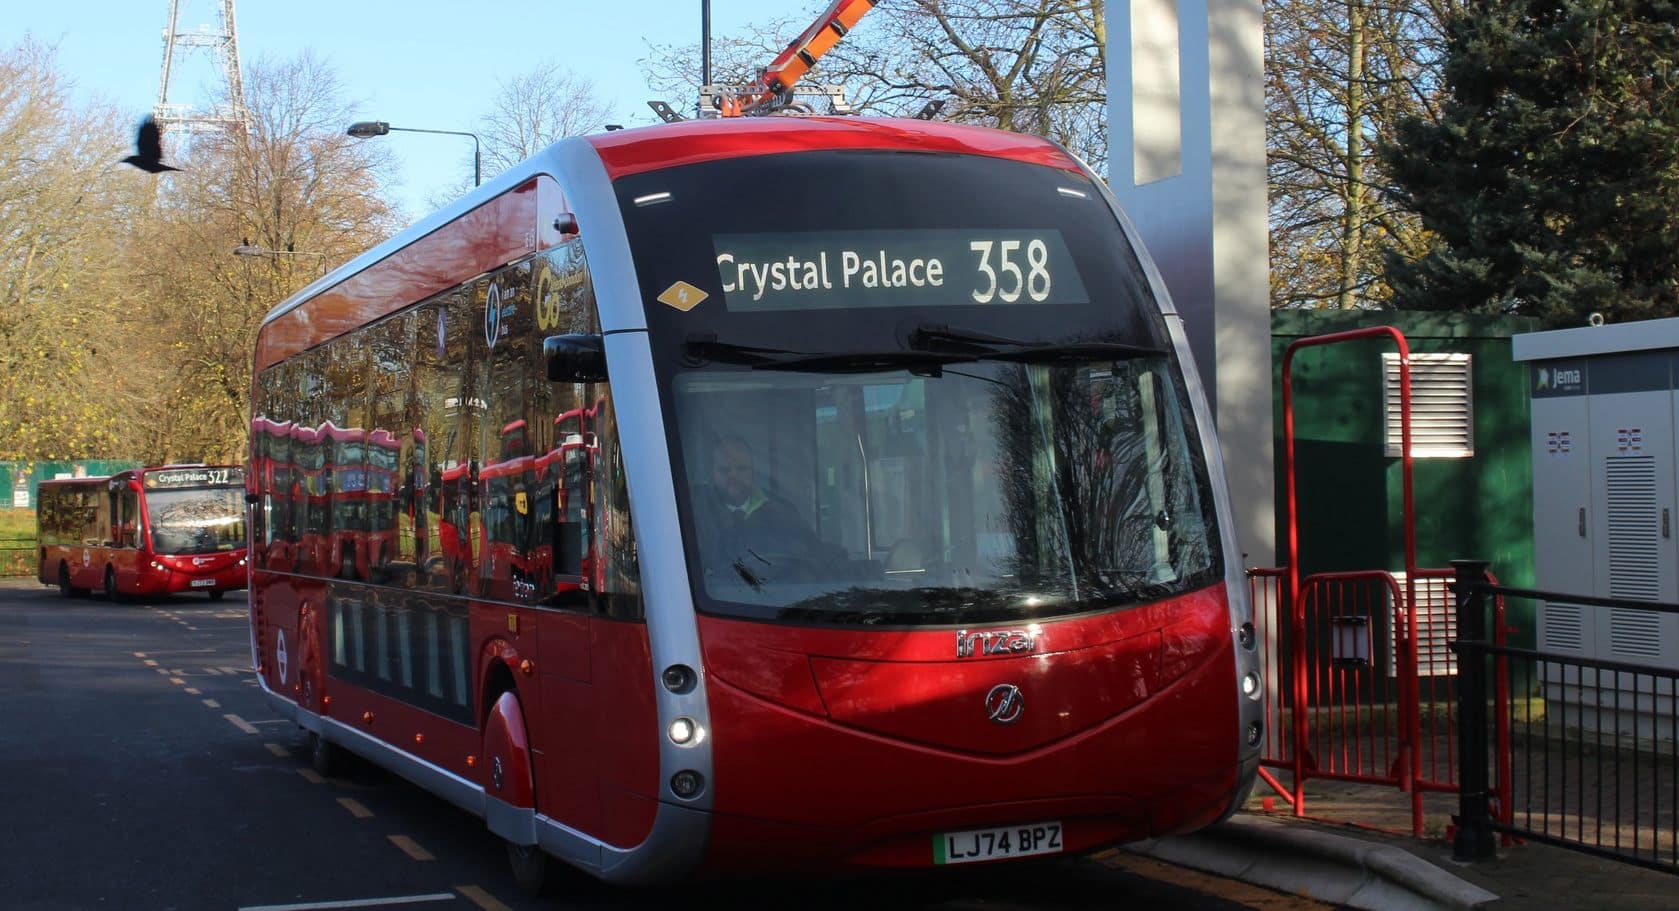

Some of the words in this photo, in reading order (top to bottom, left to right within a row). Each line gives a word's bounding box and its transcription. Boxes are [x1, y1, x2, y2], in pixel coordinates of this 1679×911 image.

[716, 251, 832, 300] Crystal
[842, 250, 944, 289] Palace
[970, 238, 1052, 304] 358
[1552, 367, 1581, 389] Jema
[158, 473, 184, 483] Crystal
[185, 472, 208, 481] Palace
[207, 470, 229, 484] 322
[949, 831, 1011, 859] LJ74
[1018, 825, 1061, 852] BPZ
